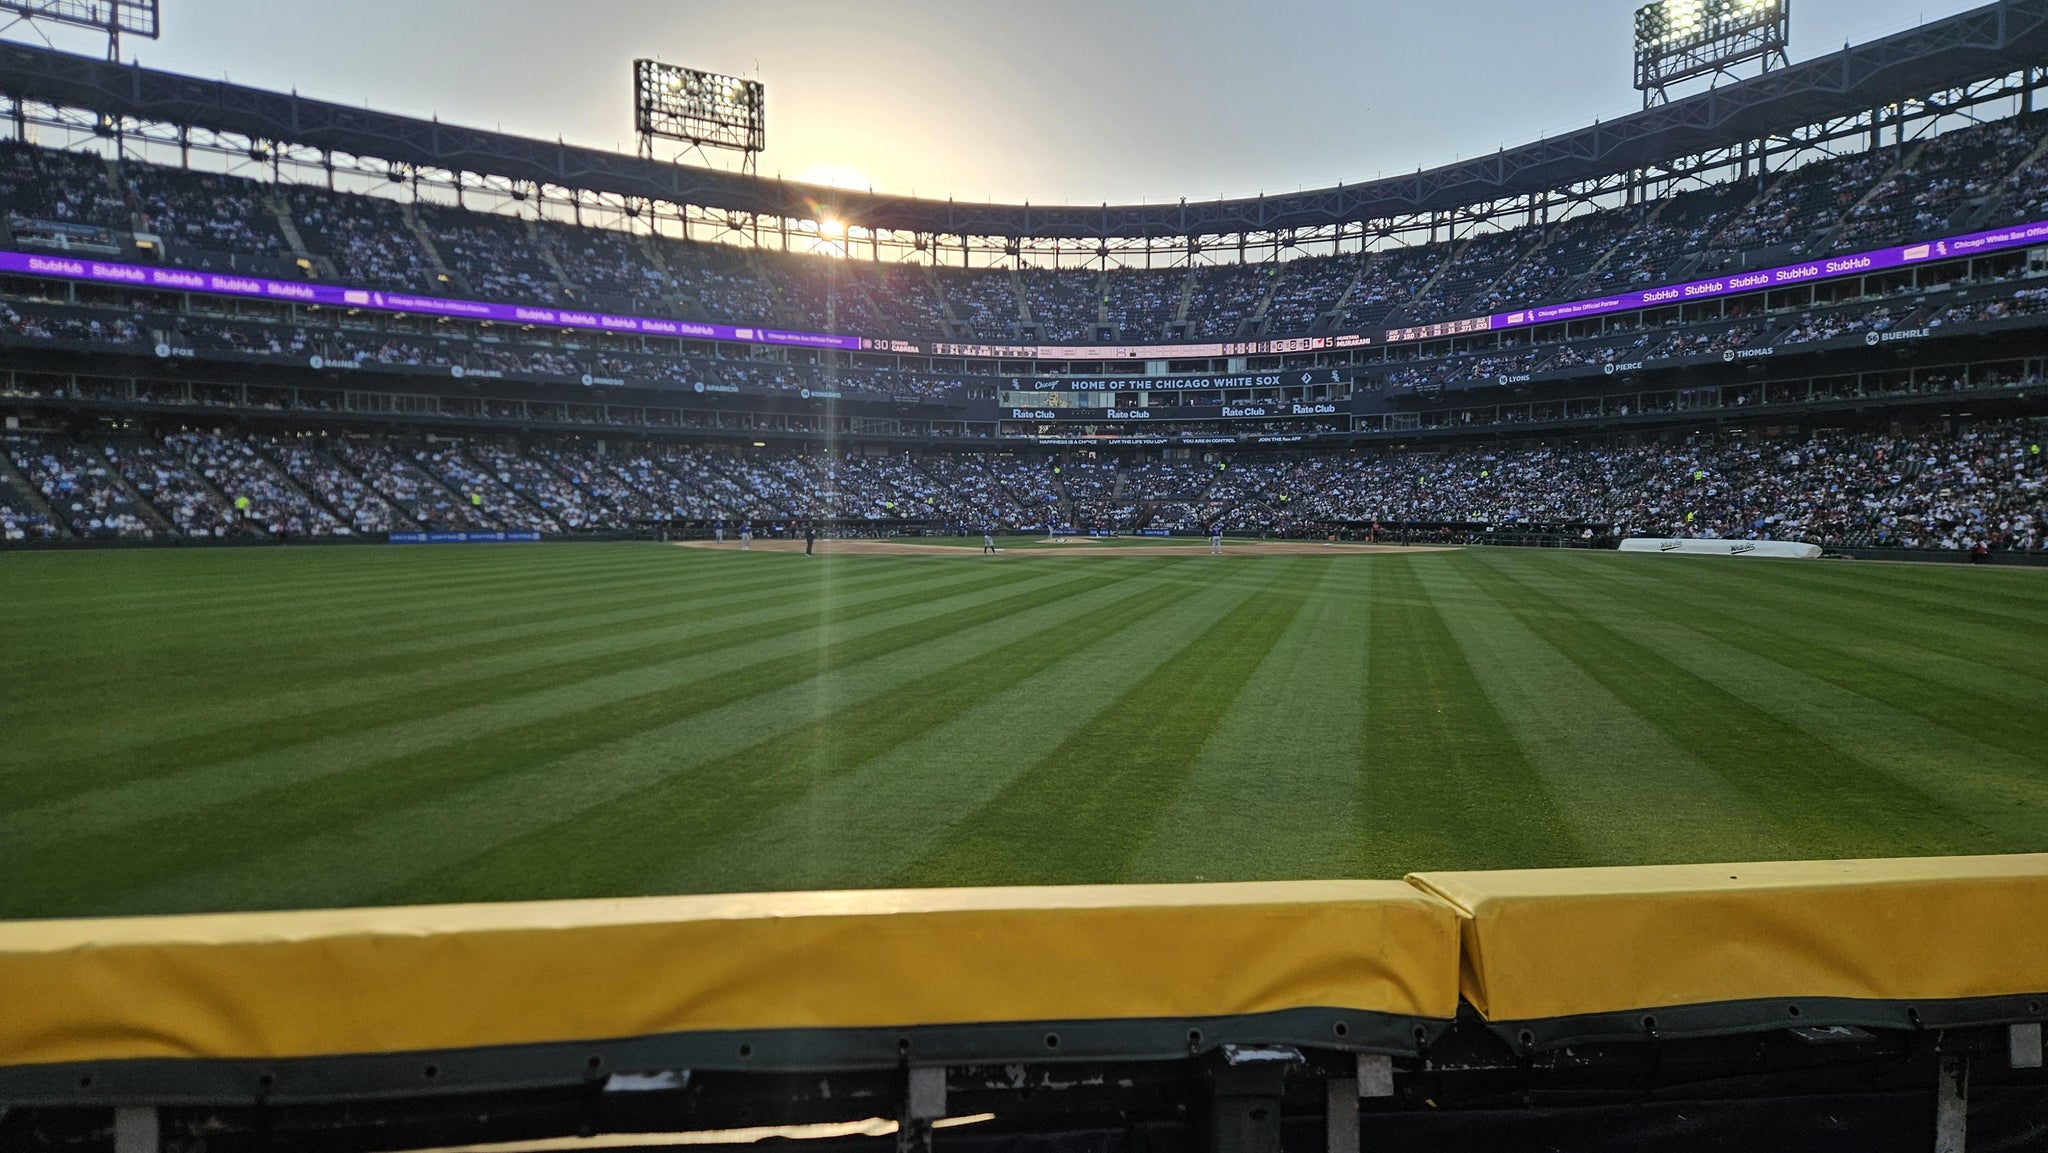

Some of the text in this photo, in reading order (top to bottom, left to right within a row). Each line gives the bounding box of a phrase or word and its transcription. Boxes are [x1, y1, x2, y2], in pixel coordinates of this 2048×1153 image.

[1954, 238, 1985, 249] Chicago
[1986, 234, 2009, 243] White
[2010, 231, 2025, 240] Sox
[29, 258, 84, 274] StubHub
[1826, 256, 1871, 273] StubHub
[92, 264, 145, 281] StubHub
[153, 270, 204, 287] StubHub
[1776, 265, 1818, 281] StubHub
[211, 276, 260, 293] StubHub
[1729, 274, 1768, 289] StubHub
[267, 282, 314, 298] StubHub
[1643, 289, 1678, 302] StubHub
[1684, 282, 1722, 296] StubHub
[515, 307, 555, 322] StubHub
[1538, 309, 1558, 317] Chicago
[1582, 302, 1600, 310] Official
[559, 311, 597, 326] StubHub
[601, 315, 637, 329] StubHub
[642, 320, 676, 333] StubHub
[681, 324, 714, 336] StubHub
[1881, 329, 1930, 341] BUEHRLE
[874, 339, 889, 350] 30
[1325, 337, 1333, 347] 5
[1337, 338, 1370, 347] MURAKAMI
[891, 345, 920, 354] CABRERA
[1737, 347, 1774, 358] THOMAS
[1615, 362, 1643, 372] PIERCE
[1071, 376, 1280, 390] HOME OF THE CHICAGO WHITE SOX
[1509, 375, 1530, 383] LYONS
[1013, 409, 1056, 419] Rate Club
[1107, 409, 1129, 418] Rate
[1130, 409, 1150, 418] Club
[1222, 407, 1265, 416] Rate Club
[1293, 404, 1336, 414] Rate Club
